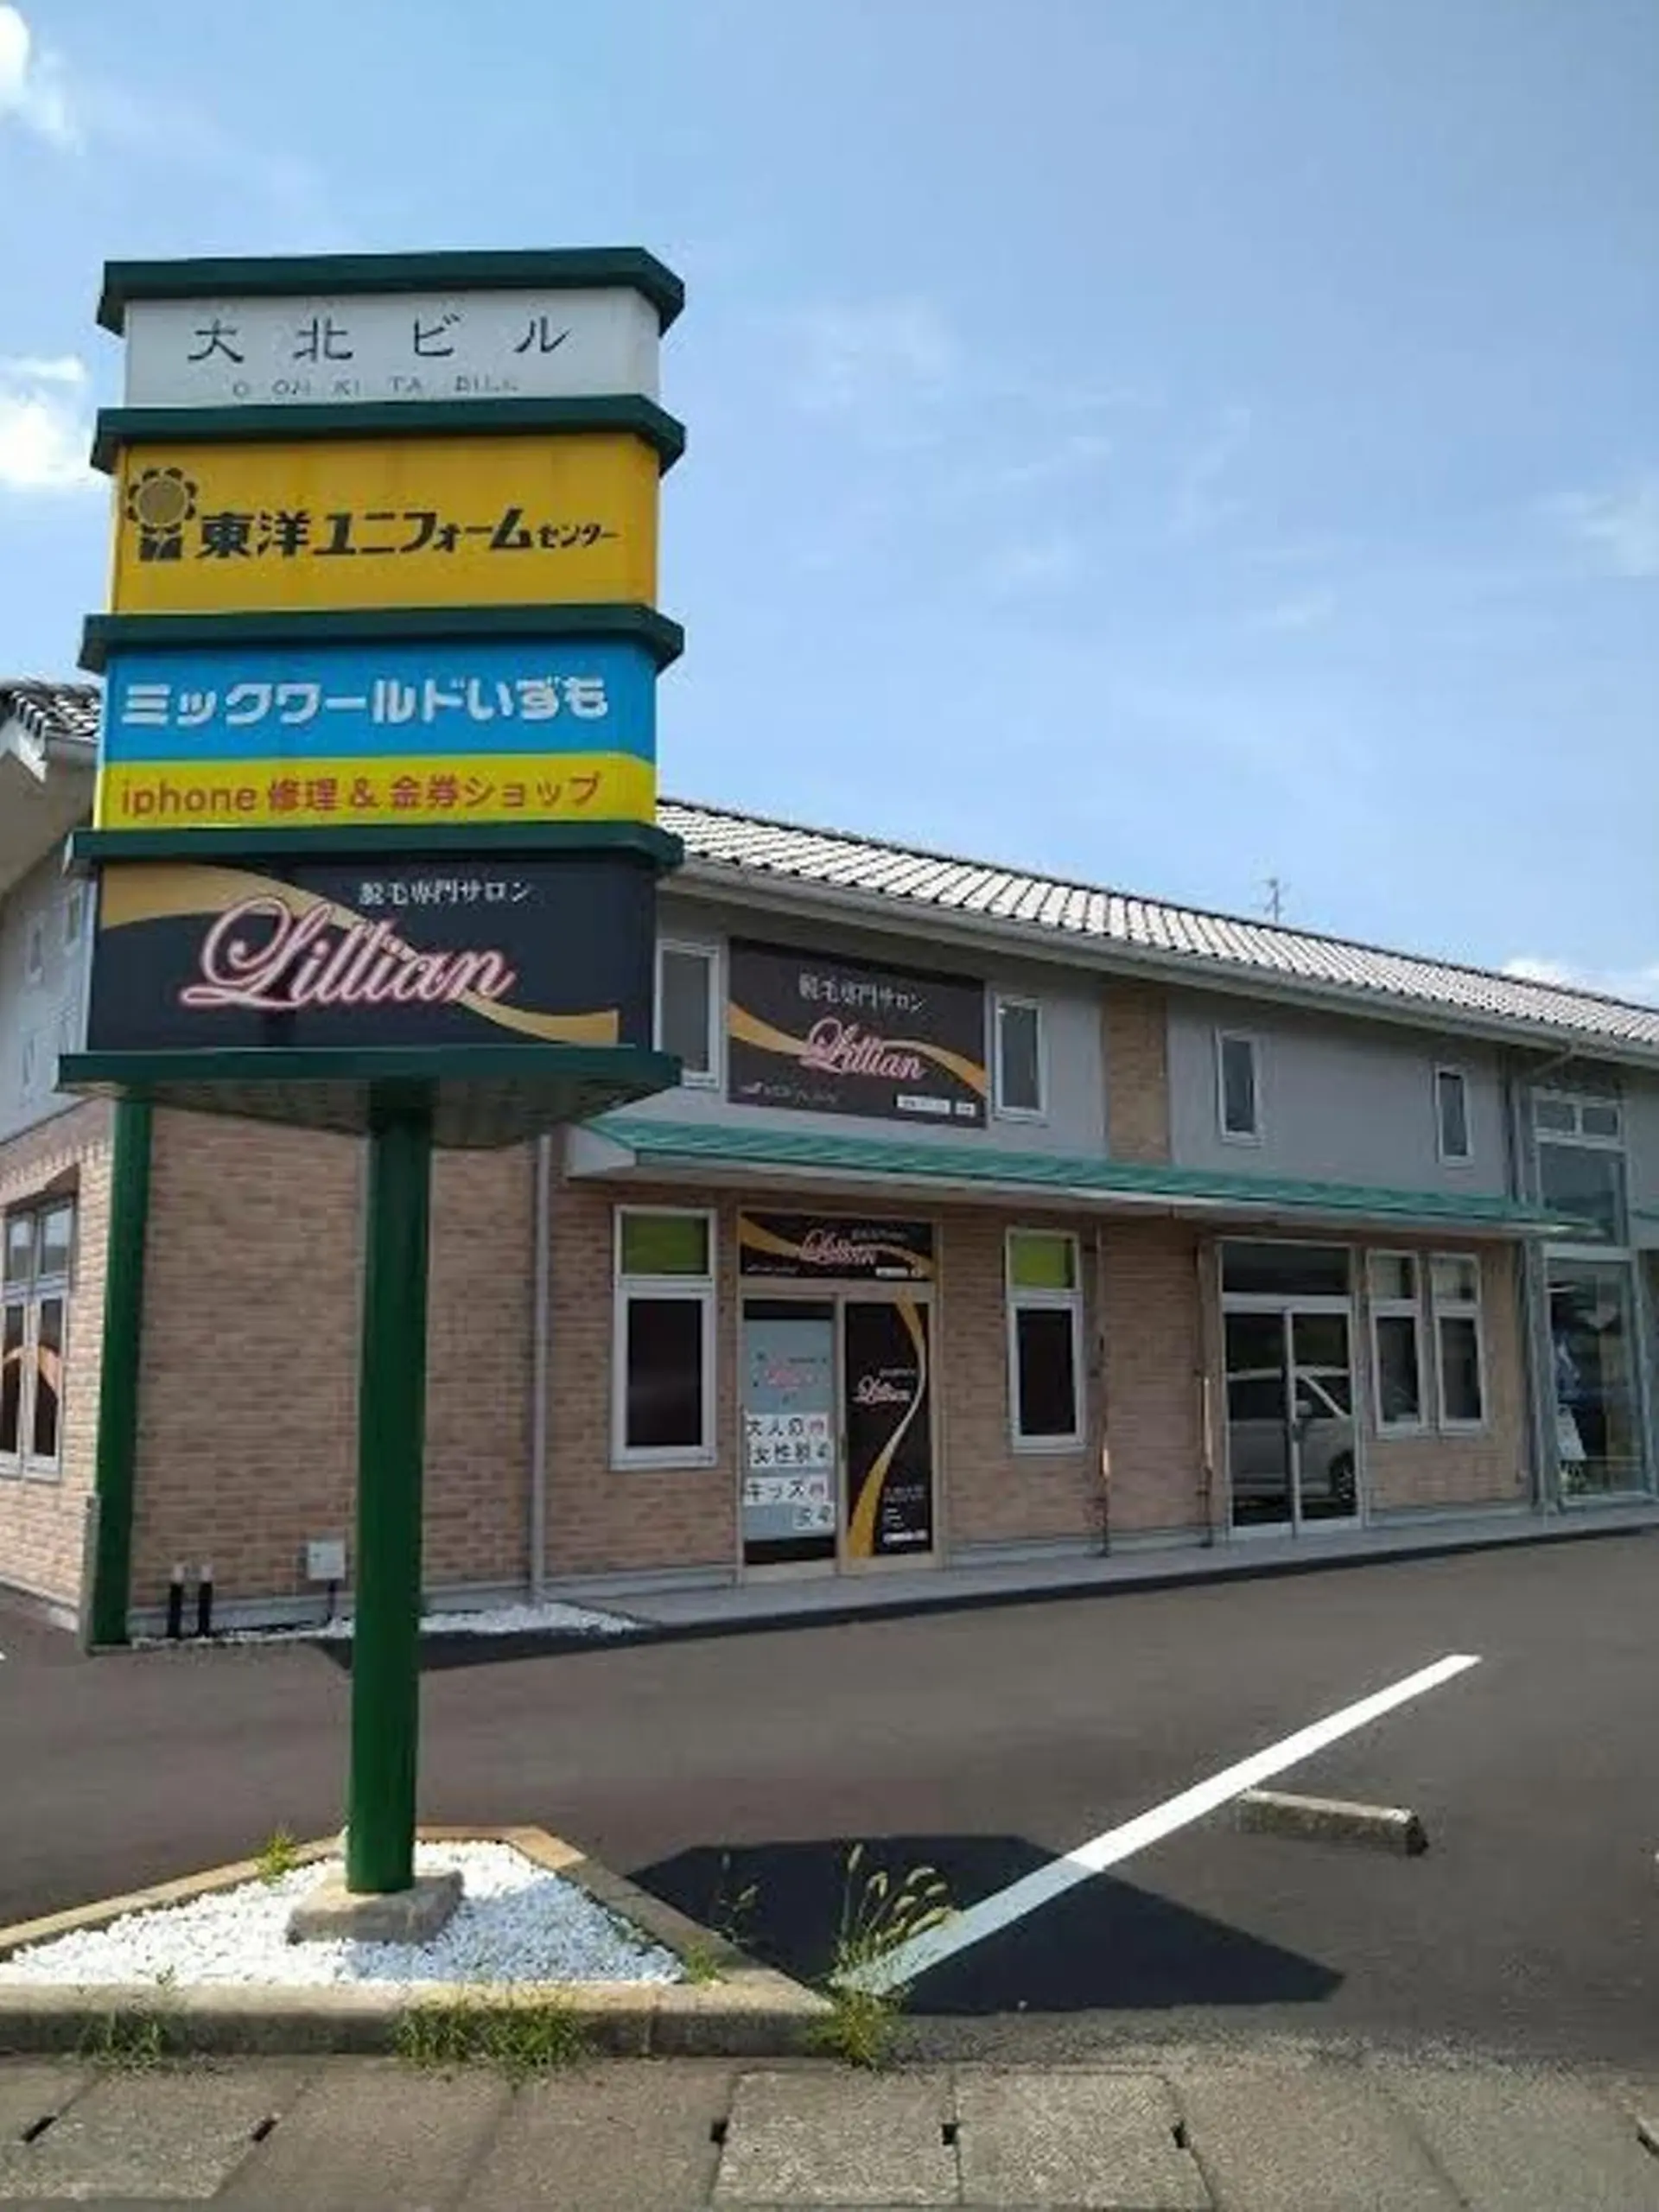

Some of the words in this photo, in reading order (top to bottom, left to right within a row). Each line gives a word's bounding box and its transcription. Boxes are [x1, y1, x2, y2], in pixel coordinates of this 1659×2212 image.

[188, 313, 570, 363] 大北ビル
[121, 676, 609, 727] ミックワールドいずも
[122, 785, 257, 817] iphone
[268, 778, 340, 813] 修理
[390, 770, 603, 809] 金券ショップ
[359, 879, 533, 906] 脱毛専門サロン
[180, 897, 517, 1010] Lillian
[798, 1016, 930, 1082] Lillian
